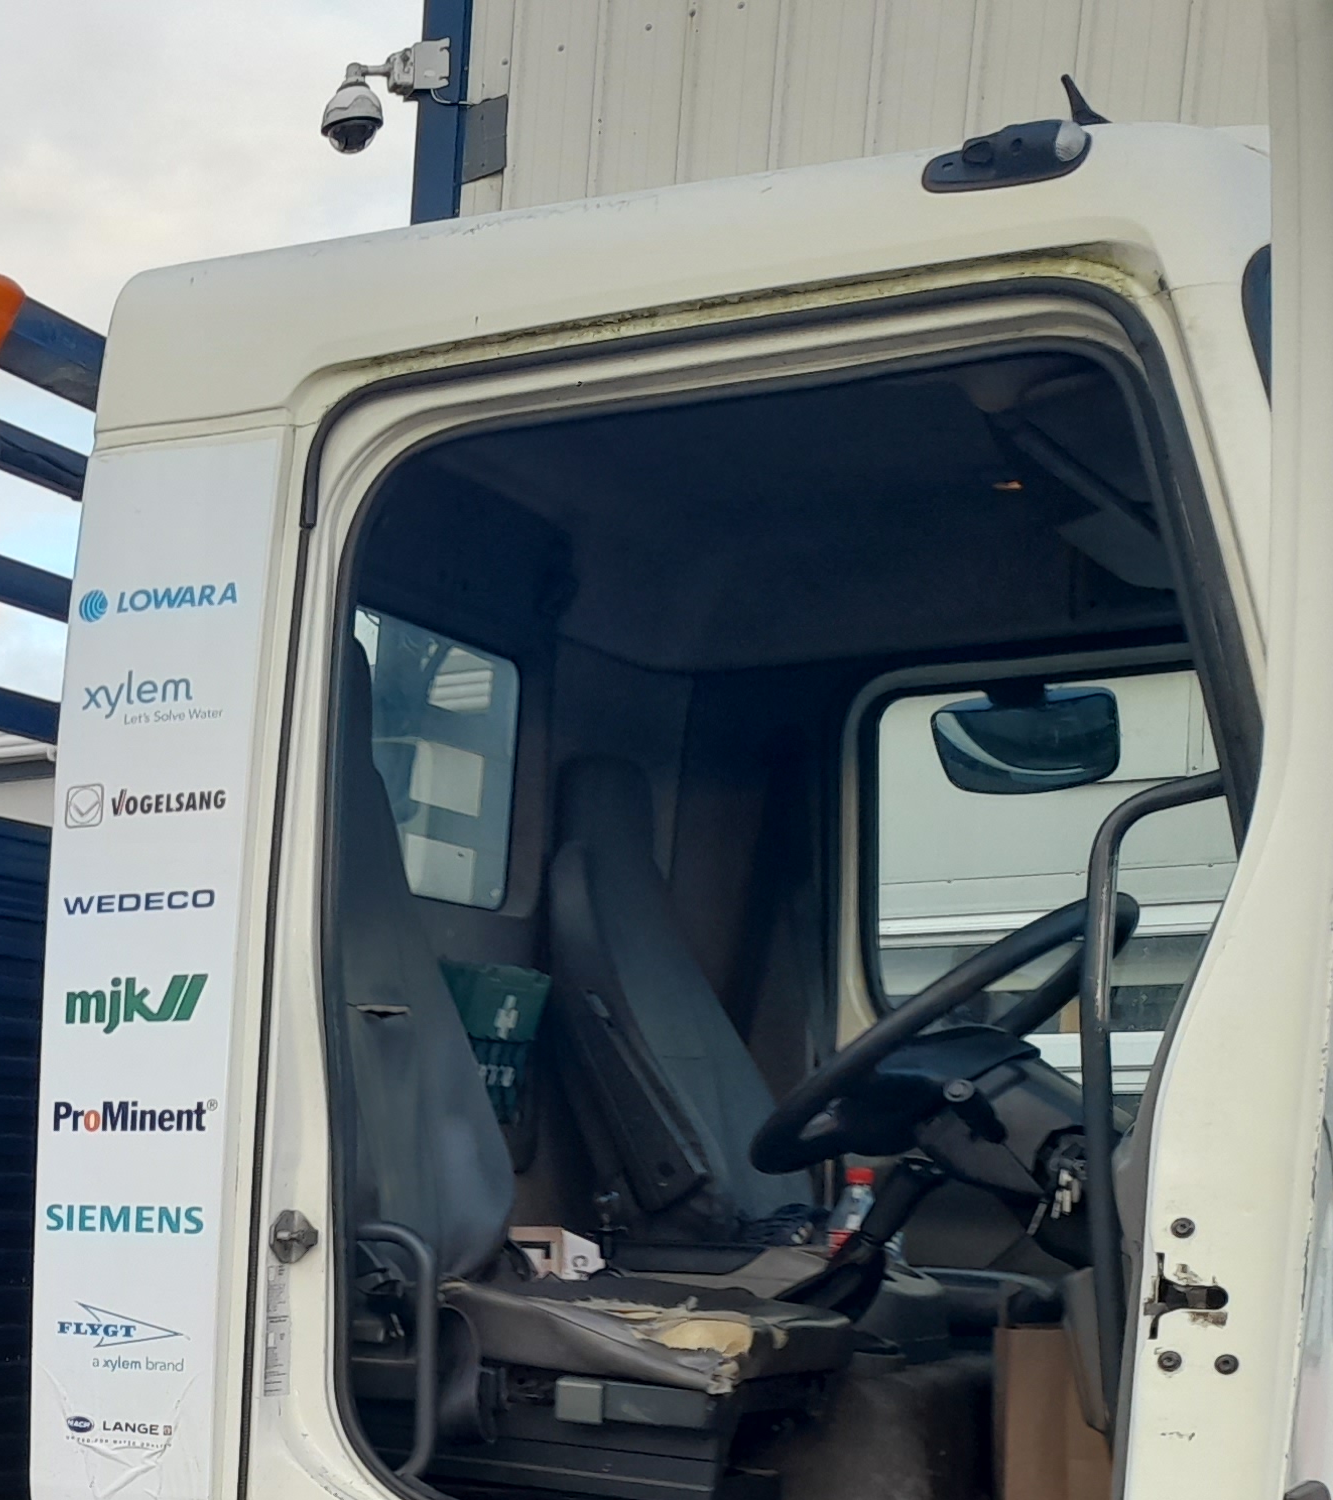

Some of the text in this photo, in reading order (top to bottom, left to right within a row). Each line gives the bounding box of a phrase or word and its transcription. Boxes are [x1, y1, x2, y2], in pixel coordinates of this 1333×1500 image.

[116, 582, 238, 613] LOWARA
[81, 670, 194, 719] xylem
[123, 706, 224, 726] Let's Solve Water
[110, 788, 227, 817] VOGELSANG
[63, 888, 216, 916] WEDECO
[64, 976, 183, 1035] mjk
[45, 1203, 204, 1236] SIEMENS
[56, 1319, 137, 1339] FLYGT
[91, 1354, 185, 1374] a xylem brand
[102, 1419, 160, 1436] LANGE
